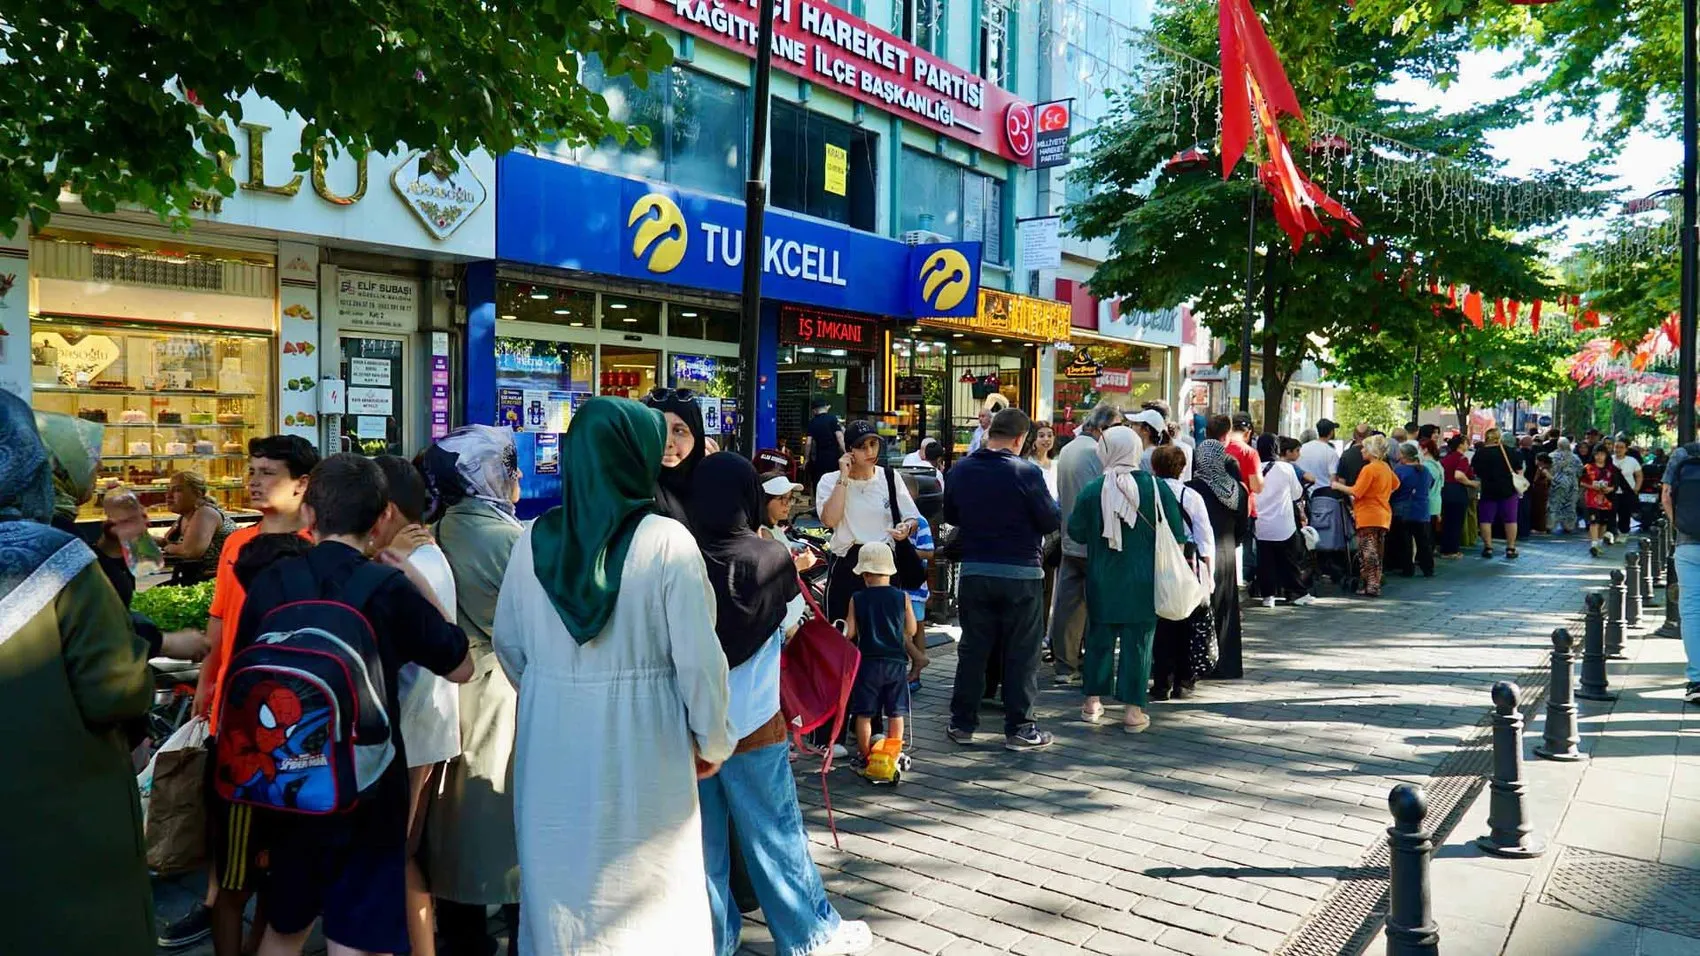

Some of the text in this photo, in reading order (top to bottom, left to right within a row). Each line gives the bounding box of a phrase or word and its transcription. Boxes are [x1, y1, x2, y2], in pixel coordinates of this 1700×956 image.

[801, 2, 985, 111] HAREKET PARTİSİ
[815, 44, 857, 87] İLÇE
[860, 70, 955, 127] BAŞKANLIĞI
[700, 222, 847, 287] TUKCELL
[798, 313, 862, 343] İŞ İMKANI
